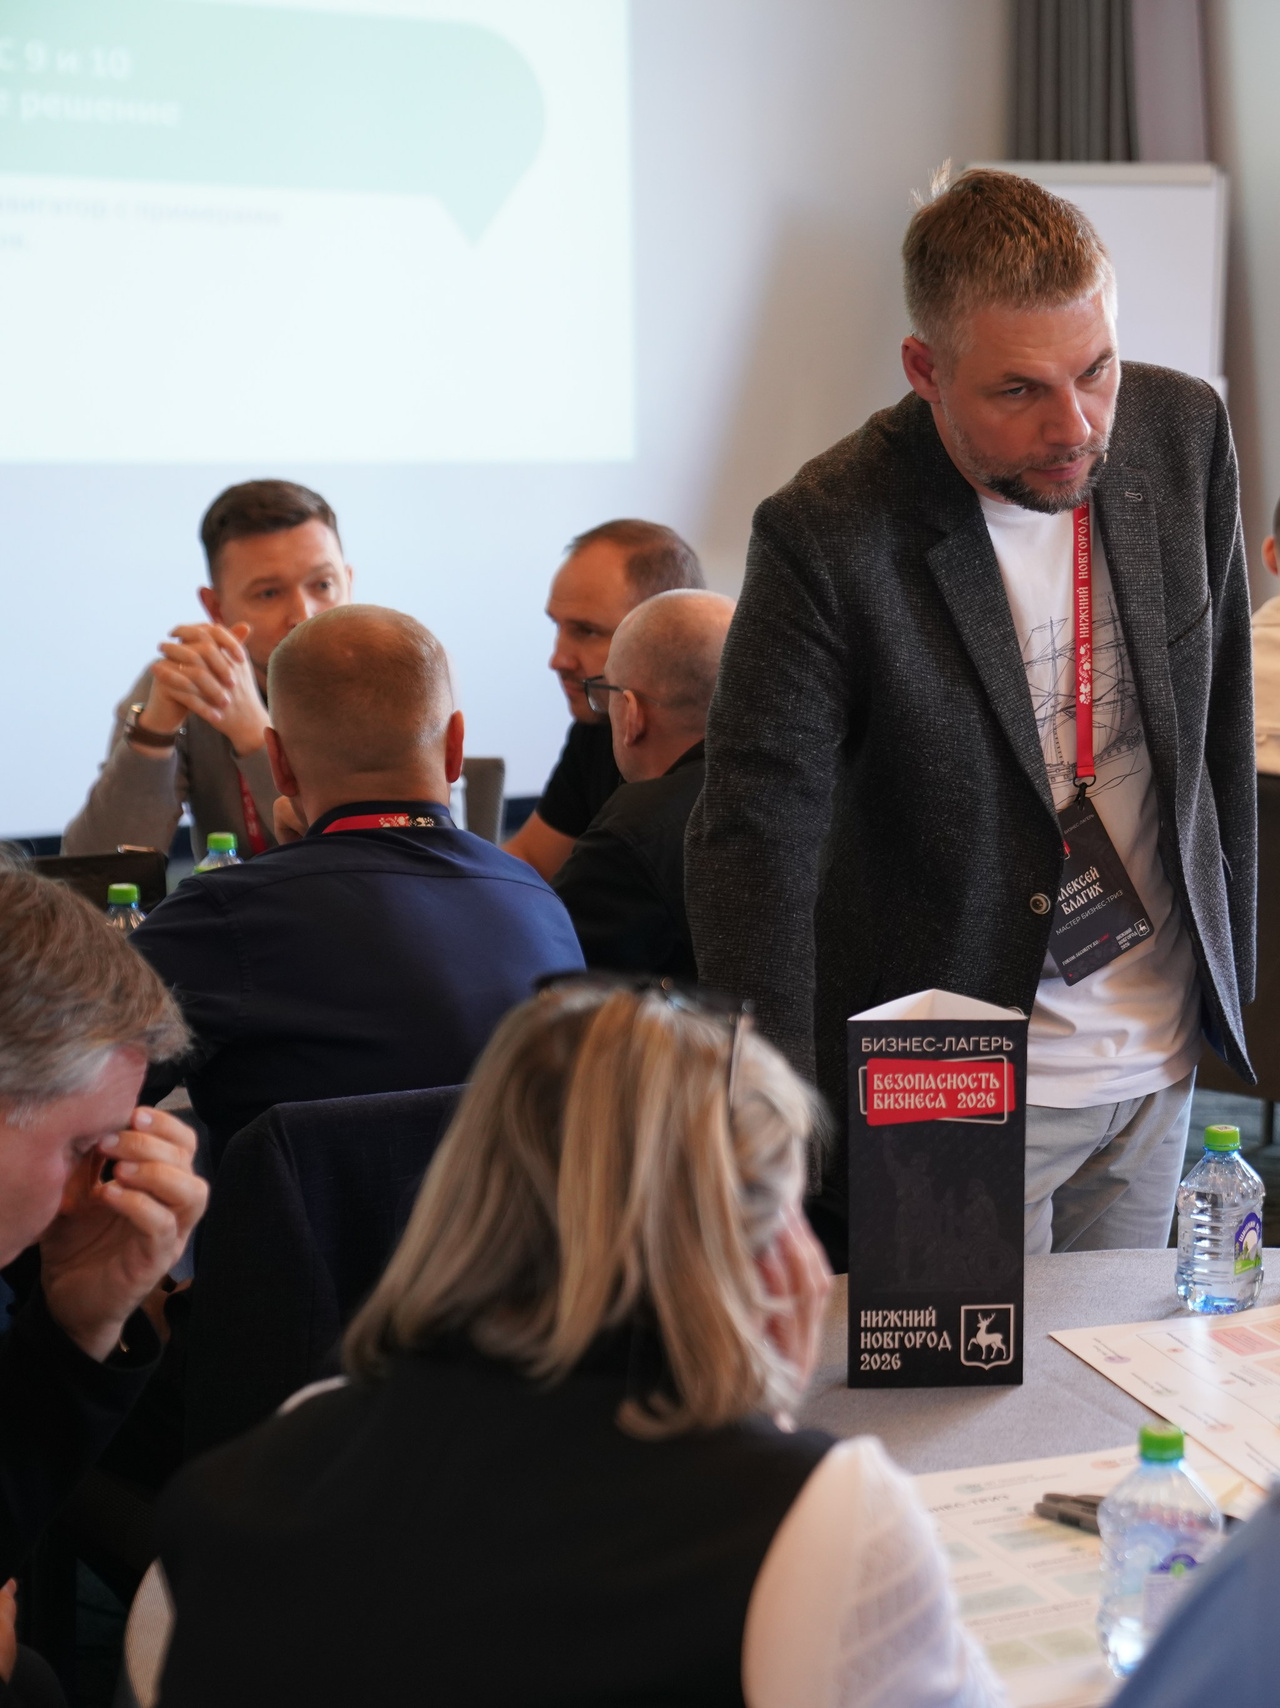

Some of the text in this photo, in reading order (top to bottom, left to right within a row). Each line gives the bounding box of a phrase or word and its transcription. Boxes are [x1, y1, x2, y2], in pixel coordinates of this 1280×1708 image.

[24, 38, 48, 74] 9
[55, 48, 81, 77] и
[90, 45, 133, 82] 10
[20, 90, 182, 127] решение
[1078, 516, 1089, 579] НОВГОРОД
[1079, 586, 1089, 638] НИЖНИЙ
[1055, 889, 1123, 935] МАСТЕР БИЗНЕС-ТРИЗ
[1061, 882, 1103, 915] БЛАГИХ
[861, 1036, 1014, 1053] БИЗНЕС-ЛАГЕРЬ
[873, 1072, 1000, 1091] БЕЗОПАСНОСТЬ
[873, 1091, 996, 1110] БИЗНЕСА 2026
[860, 1305, 937, 1328] НИЖНИЙ
[860, 1329, 953, 1352] НОВГОРОД
[860, 1352, 902, 1371] 2026
